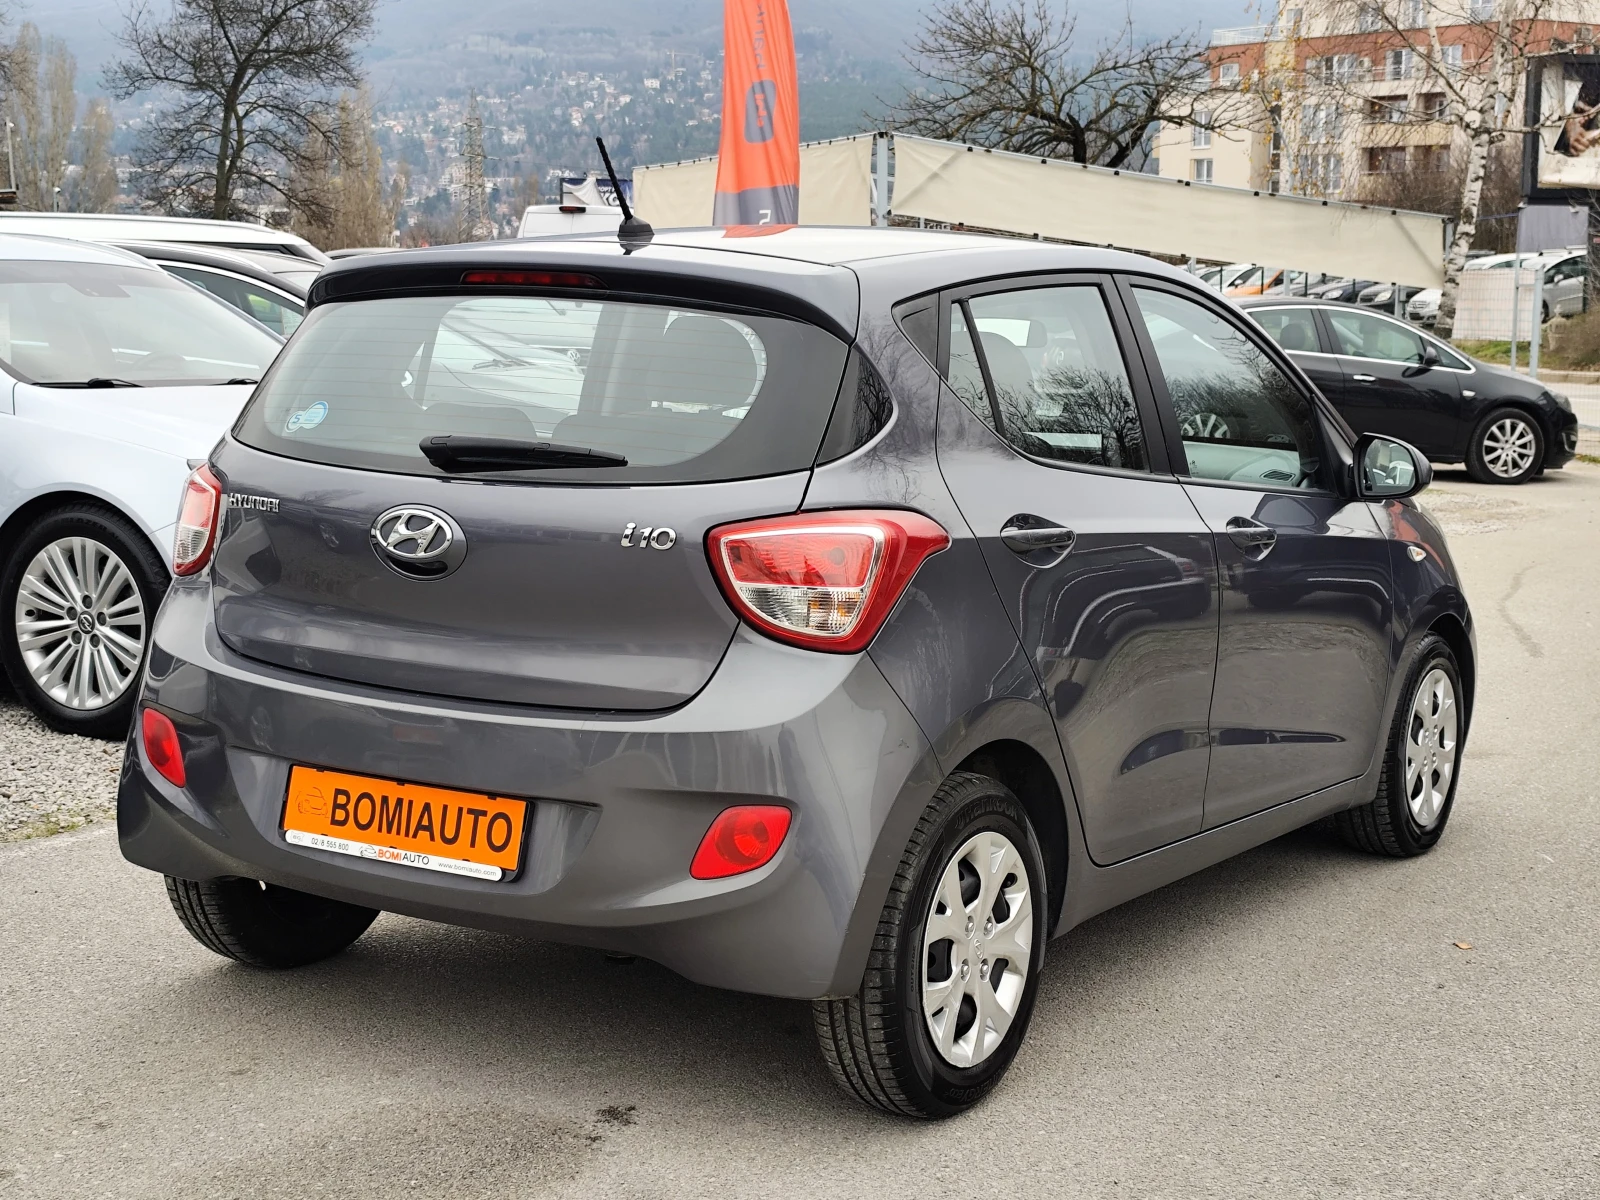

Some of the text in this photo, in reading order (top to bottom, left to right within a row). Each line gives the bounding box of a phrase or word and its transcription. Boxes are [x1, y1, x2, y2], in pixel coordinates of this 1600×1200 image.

[229, 492, 280, 513] HYUNDAI
[620, 522, 677, 551] i10
[330, 788, 513, 853] BOMIAUTO
[438, 861, 497, 877] www.bomiauto.com
